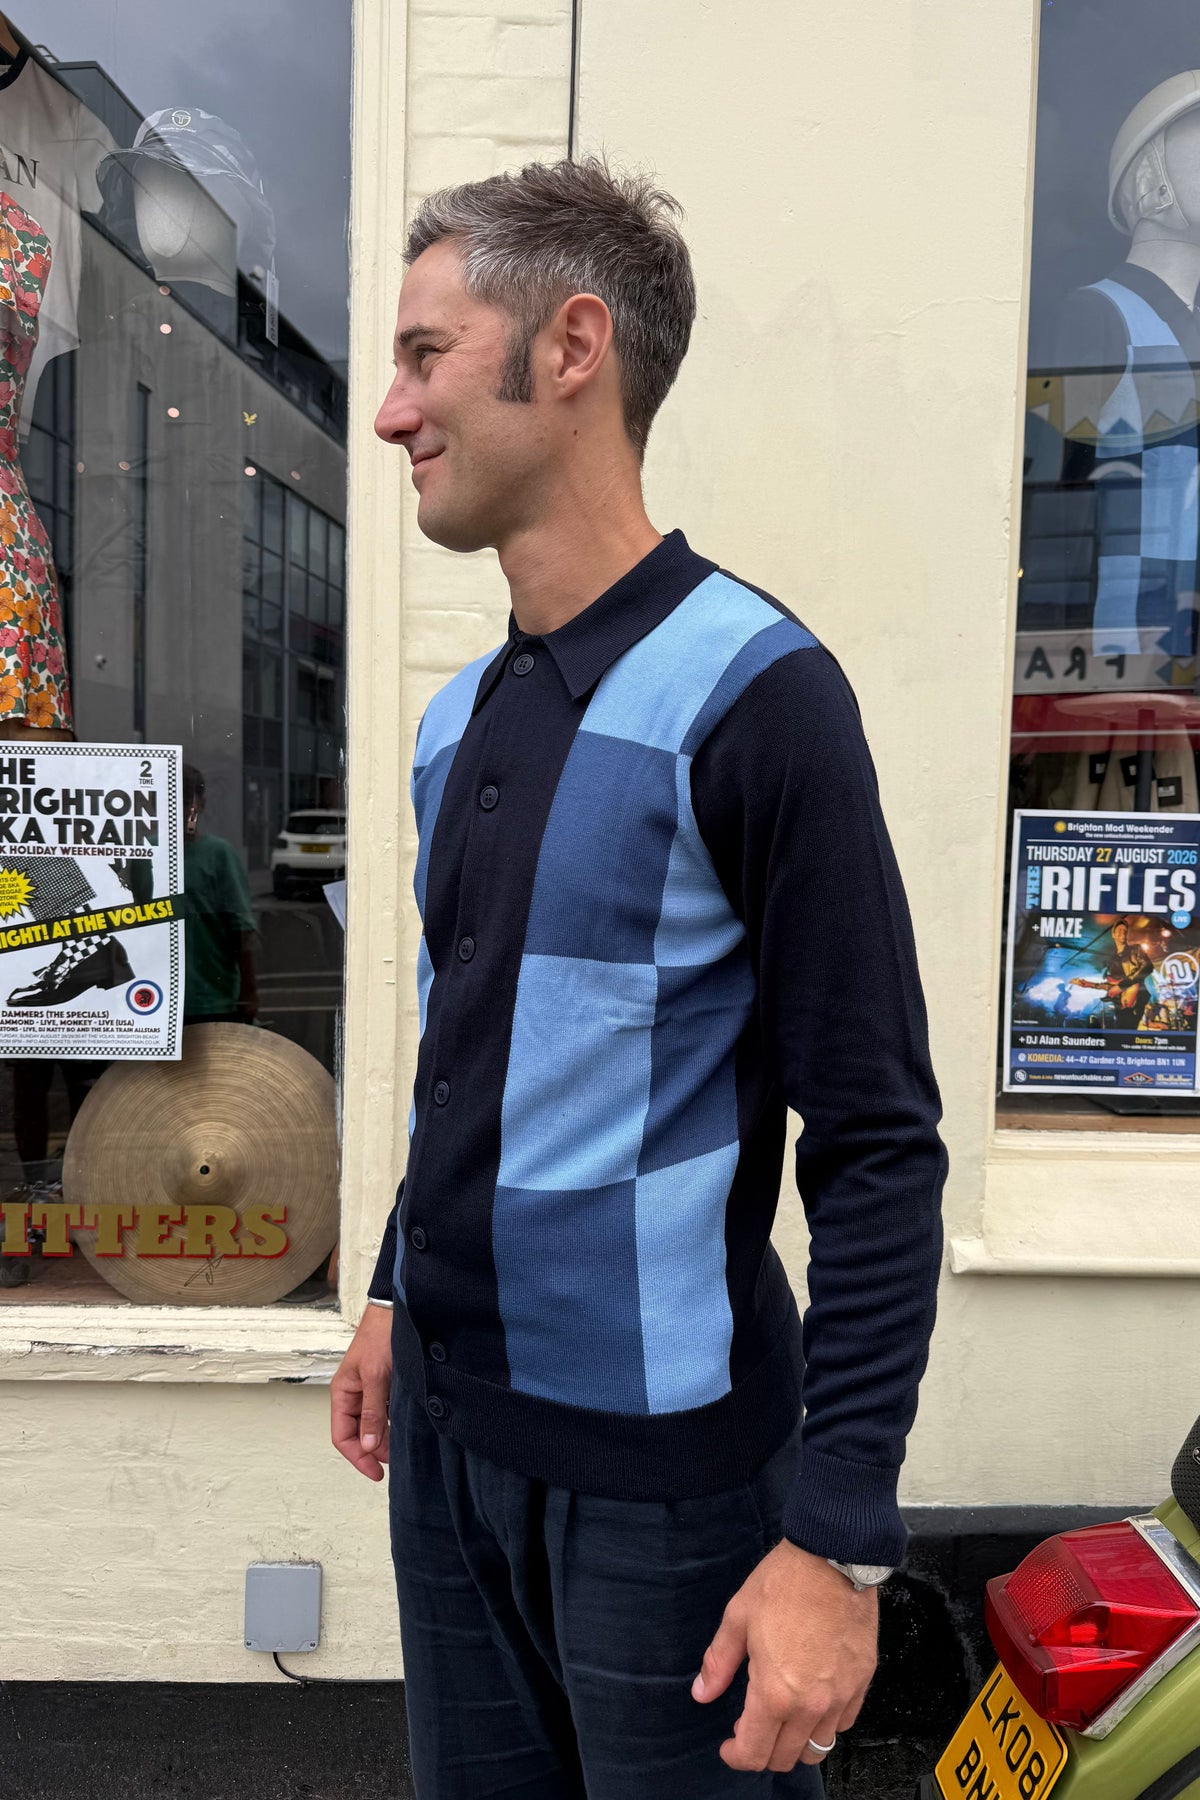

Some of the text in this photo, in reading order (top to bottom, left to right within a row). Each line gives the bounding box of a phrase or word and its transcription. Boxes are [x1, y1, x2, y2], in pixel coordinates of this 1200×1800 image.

[0, 758, 35, 785] HE
[140, 761, 152, 777] 2
[0, 787, 157, 817] RIGHTON
[0, 817, 159, 846] KA TRAIN
[1067, 822, 1174, 834] Brighton Mod Weekender
[10, 846, 57, 855] HOLIDAY
[60, 847, 127, 857] WEEKENDER
[130, 848, 154, 857] 2026
[1026, 846, 1197, 865] THURSDAY 27 AUGUST 2026
[1041, 866, 1197, 913] RIFLES
[0, 900, 174, 950] IGHT! AT THE VOLKS!
[2, 1010, 109, 1019] DAMMERS (THE SPECIALS)
[1039, 1035, 1060, 1045] Alan
[1062, 1036, 1105, 1047] Saunders
[1027, 1053, 1064, 1063] KOMEDIA:
[1088, 1056, 1115, 1065] Gardner
[1127, 1057, 1155, 1067] Brighton
[2, 1203, 287, 1258] ITTERS
[981, 1672, 1045, 1800] LK08
[955, 1738, 1000, 1800] BN
